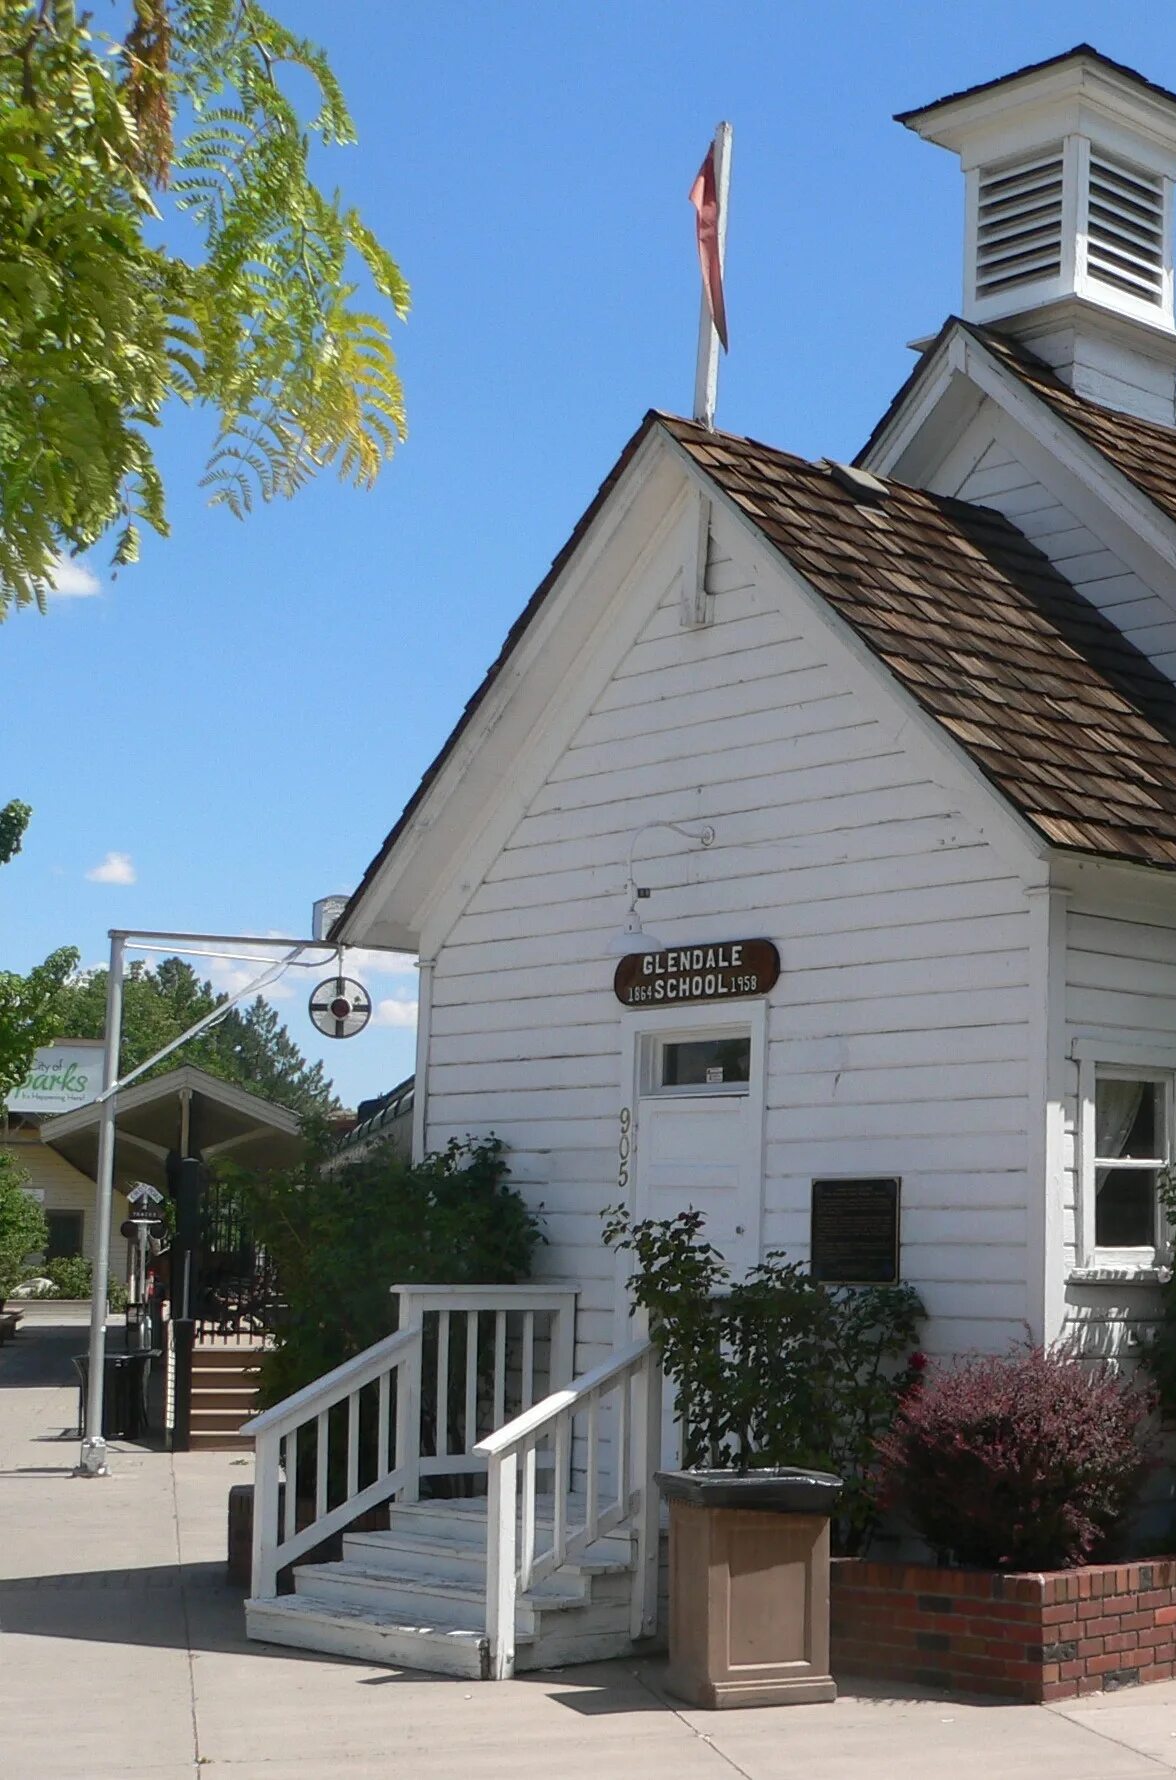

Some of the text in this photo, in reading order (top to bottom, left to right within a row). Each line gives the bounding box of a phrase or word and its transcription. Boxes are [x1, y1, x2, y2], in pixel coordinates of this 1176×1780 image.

[642, 945, 743, 975] GLENDALE
[628, 973, 757, 1002] 1864 SCHOOL 1958
[52, 1058, 64, 1072] of
[14, 1062, 88, 1099] parks
[618, 1107, 630, 1188] 905
